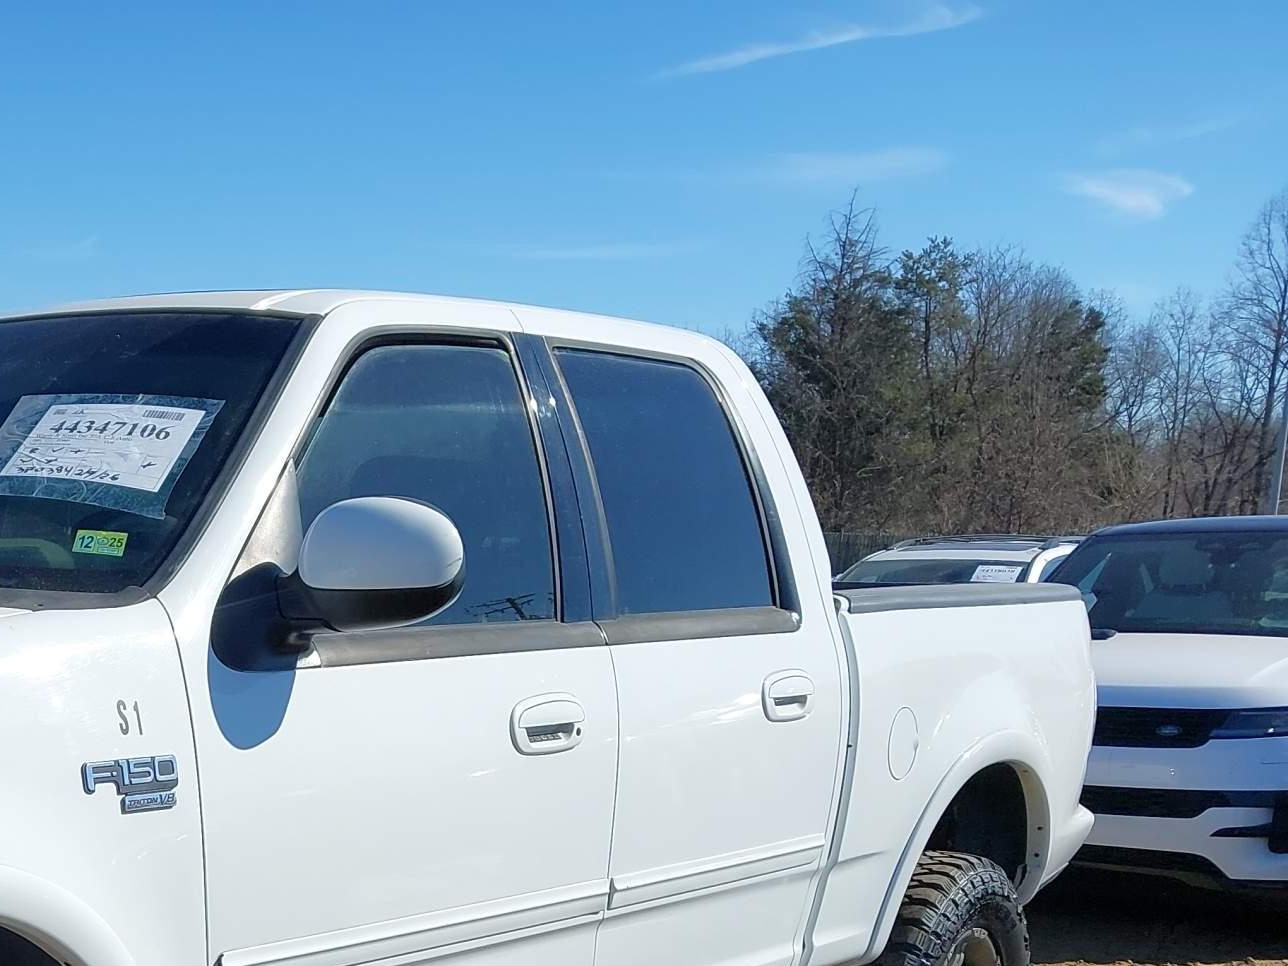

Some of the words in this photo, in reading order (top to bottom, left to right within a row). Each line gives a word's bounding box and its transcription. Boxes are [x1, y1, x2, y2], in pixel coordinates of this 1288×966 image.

[49, 420, 174, 440] 44347106
[78, 536, 94, 549] 12
[109, 537, 123, 548] 25
[116, 699, 143, 736] S1
